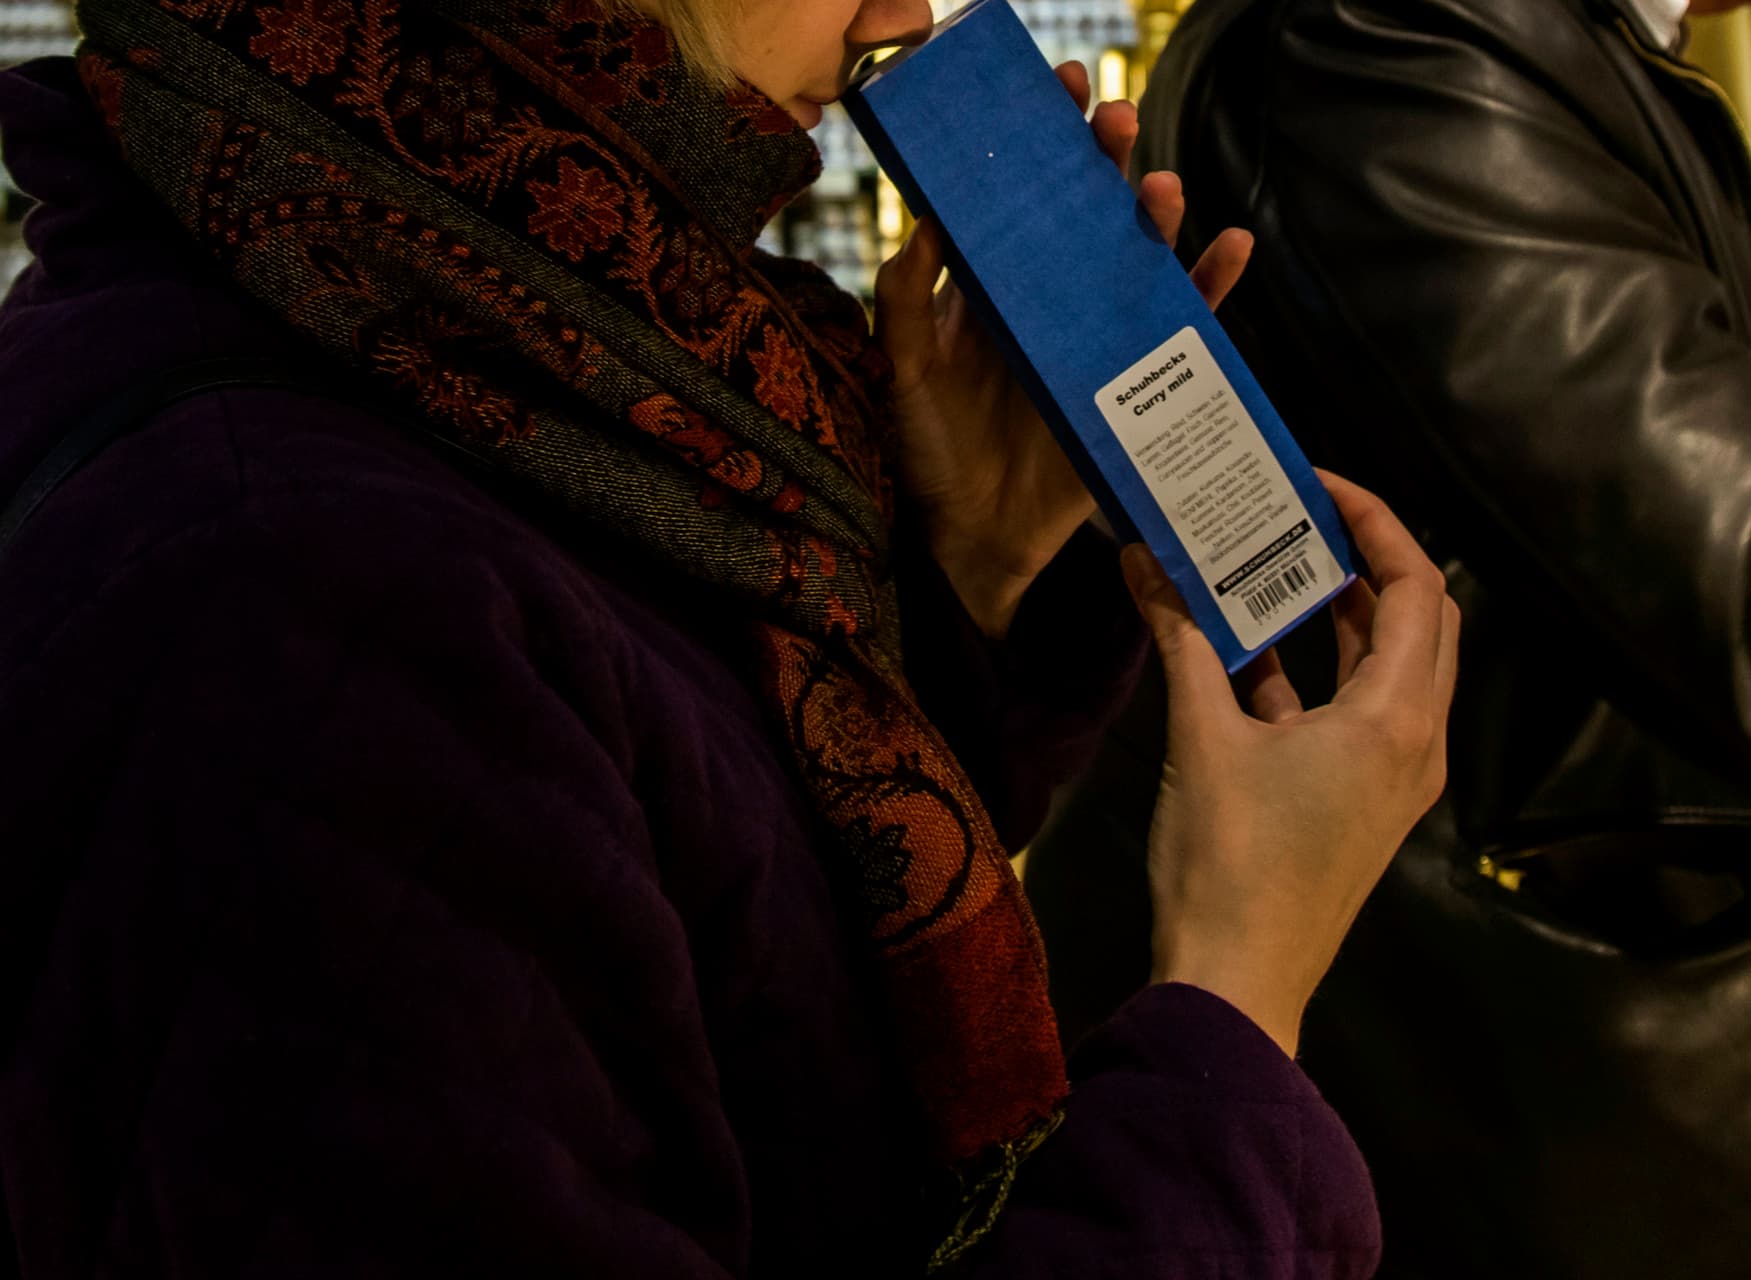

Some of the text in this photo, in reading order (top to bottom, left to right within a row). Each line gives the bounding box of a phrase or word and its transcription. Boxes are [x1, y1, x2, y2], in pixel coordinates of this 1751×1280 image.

[1116, 353, 1186, 405] Schuhbecks
[1134, 368, 1193, 416] Curry mild
